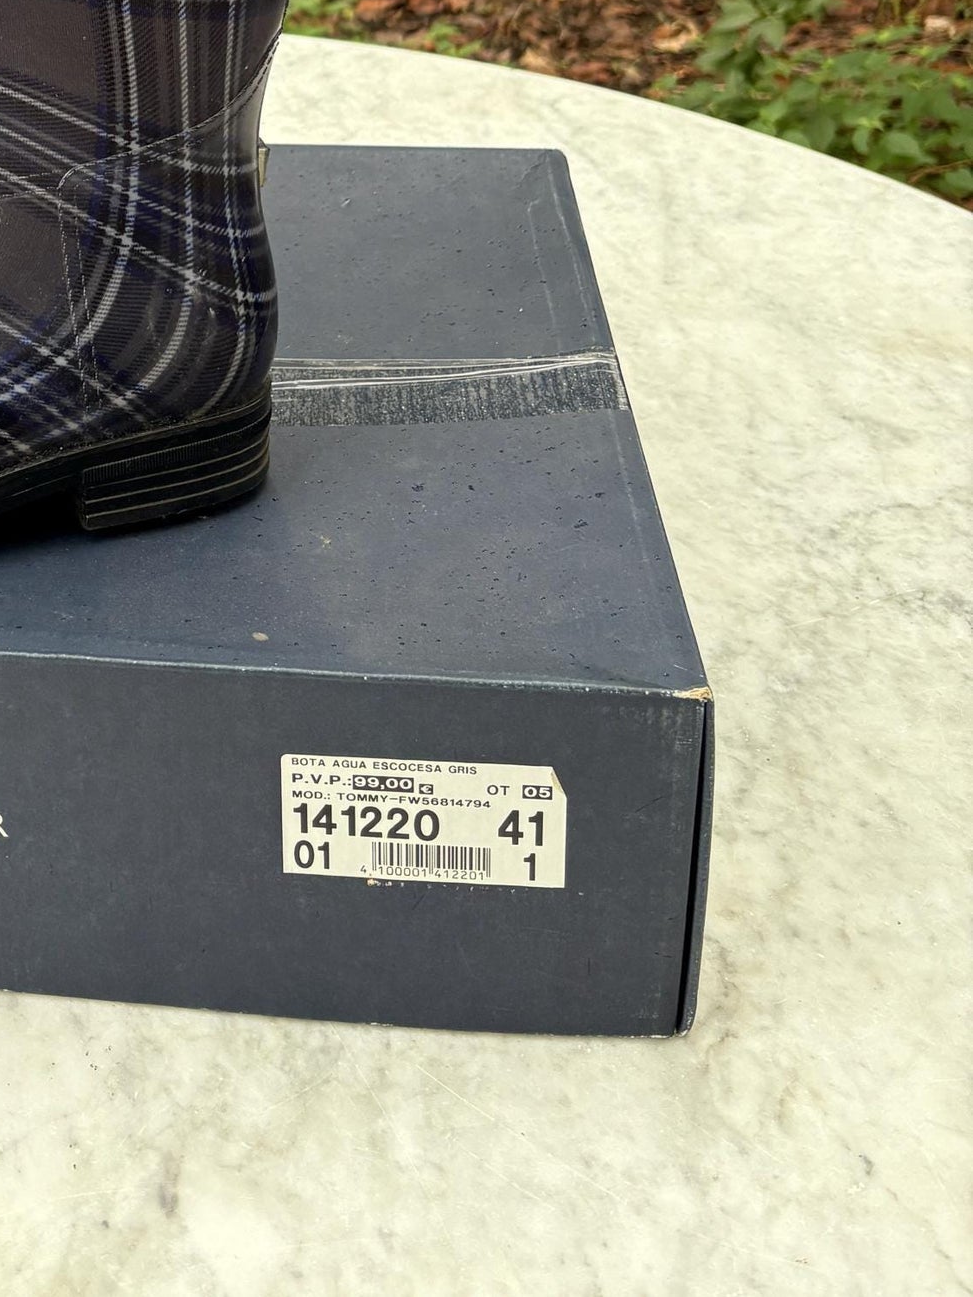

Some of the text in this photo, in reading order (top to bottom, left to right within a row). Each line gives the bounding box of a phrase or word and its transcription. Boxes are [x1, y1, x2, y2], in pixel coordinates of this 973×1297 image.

[291, 758, 477, 775] BOTA AGUA ESCOCESA GRIS
[292, 791, 491, 808] MOD.: TOMMY-FW56814794
[487, 785, 509, 796] OT
[524, 787, 551, 799] 05
[293, 803, 544, 846] 141220 41
[294, 841, 330, 869] 01
[524, 853, 536, 881] 1
